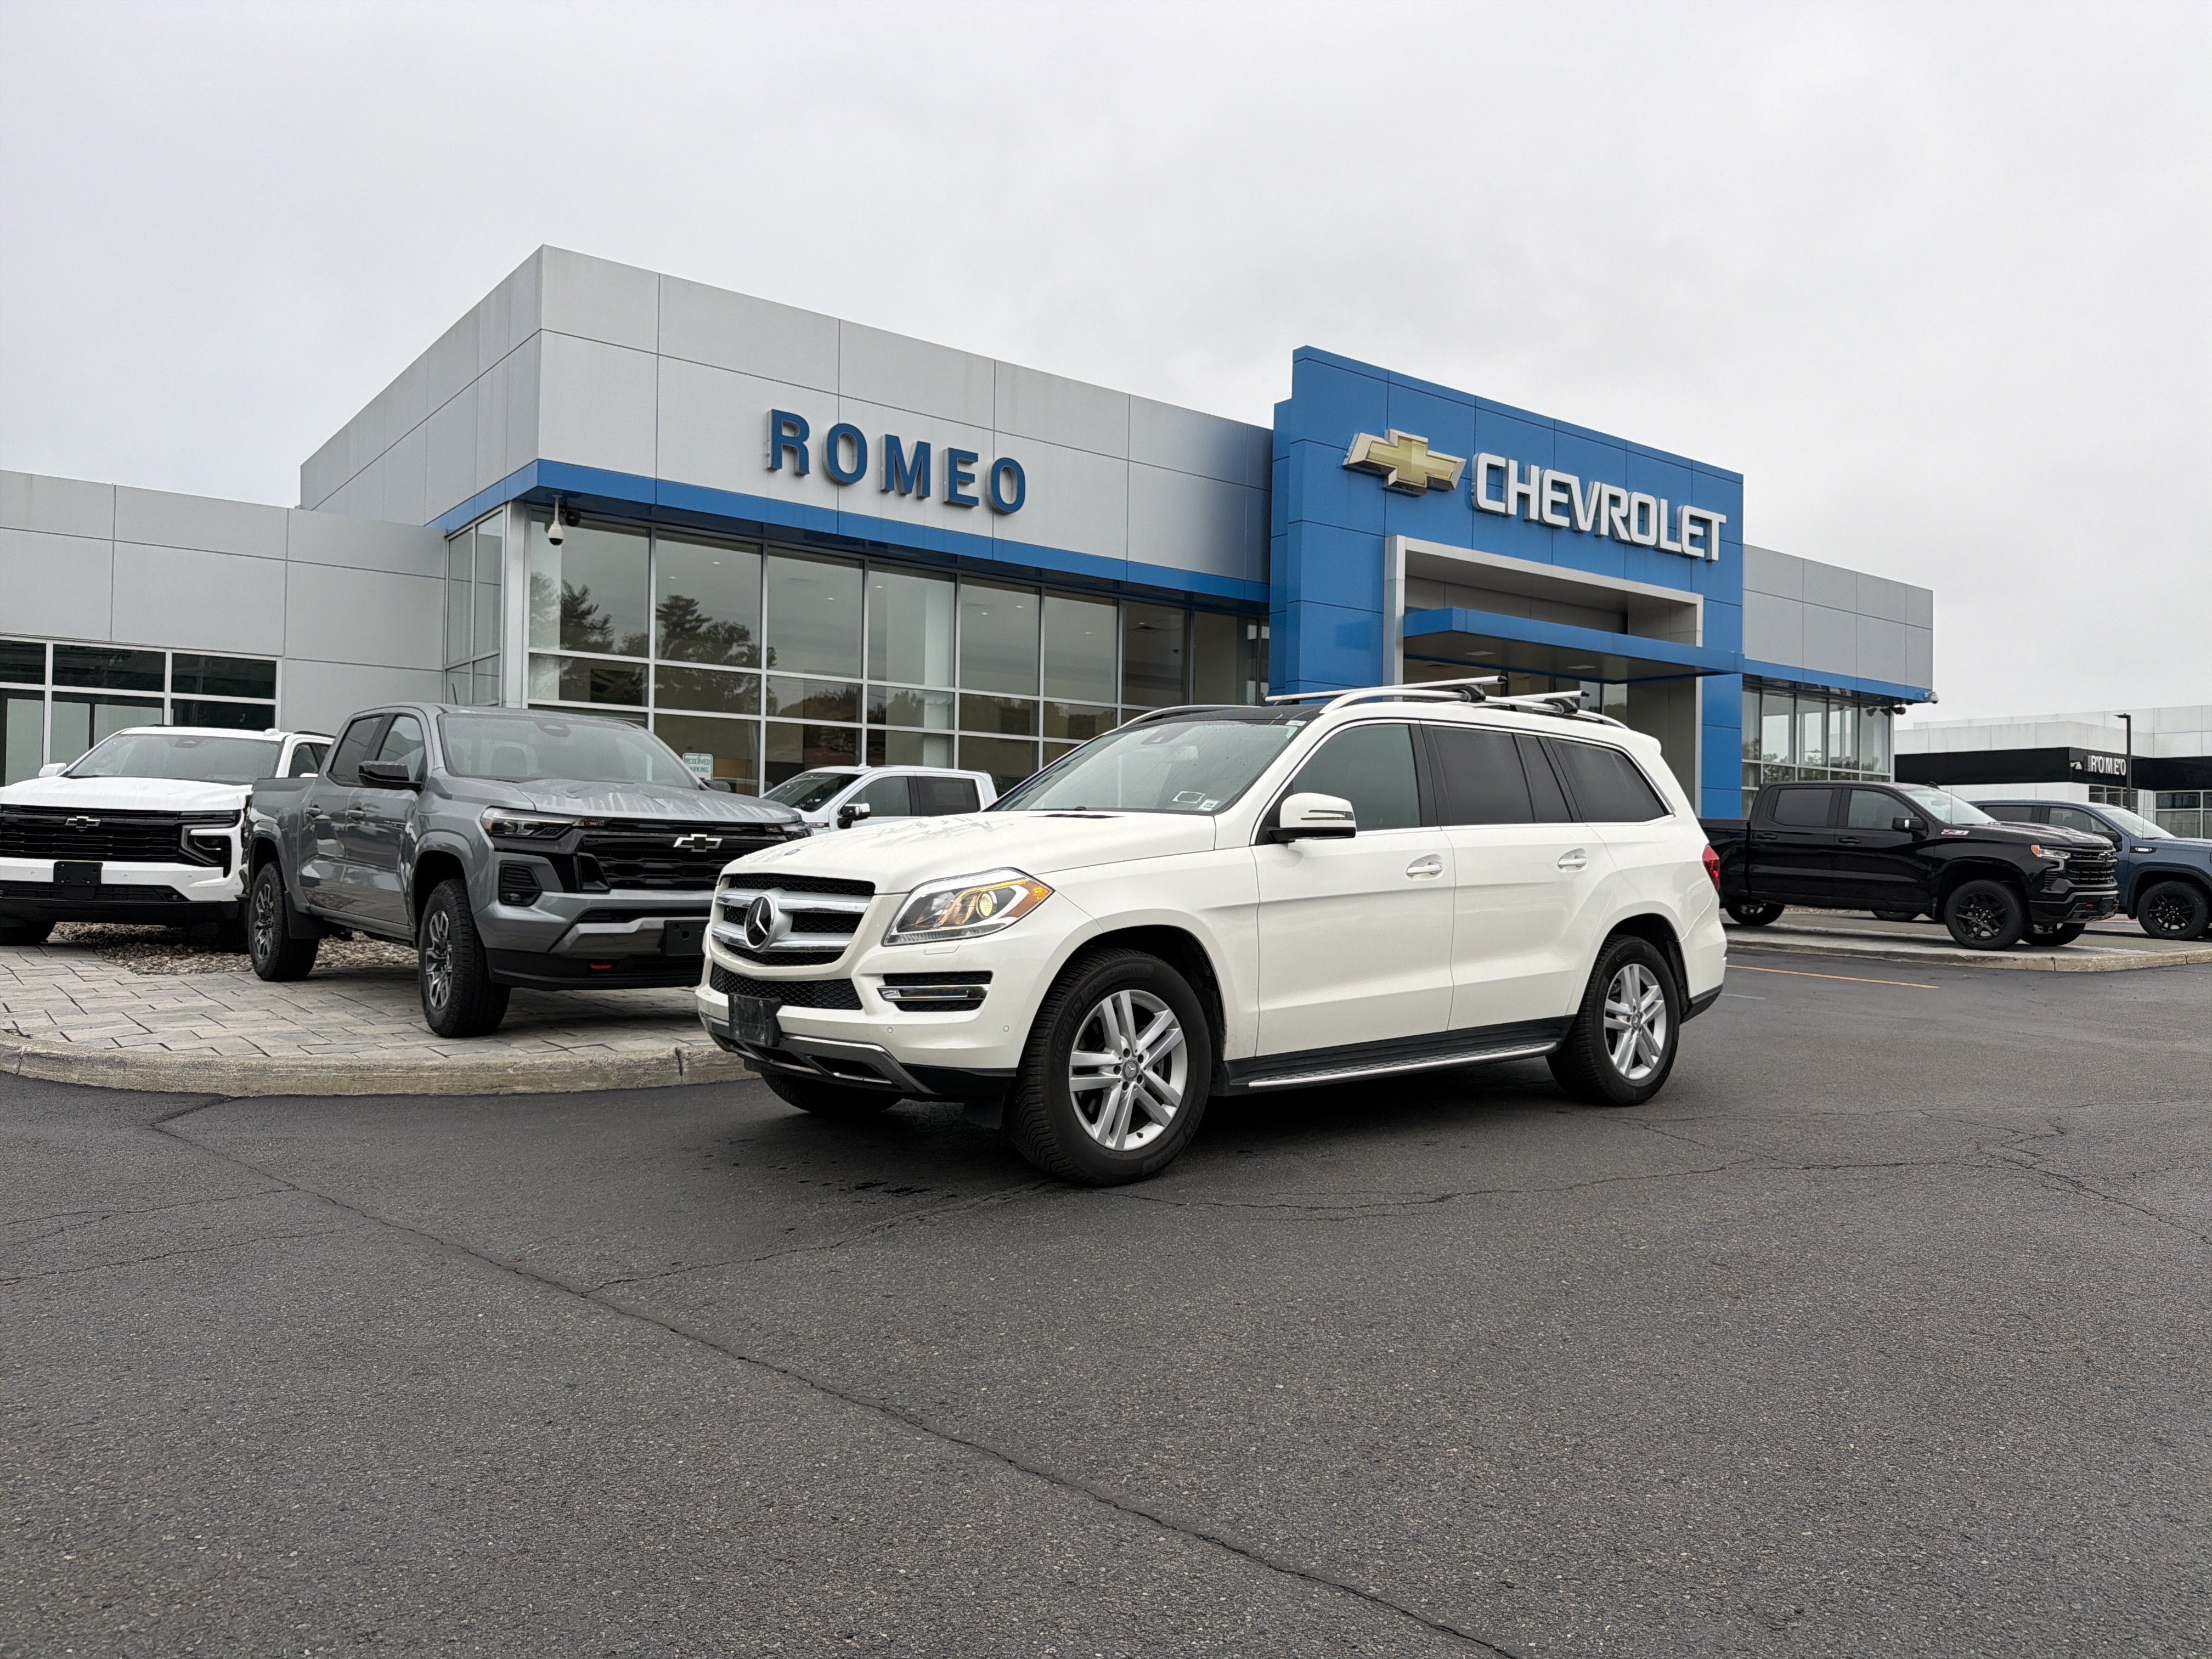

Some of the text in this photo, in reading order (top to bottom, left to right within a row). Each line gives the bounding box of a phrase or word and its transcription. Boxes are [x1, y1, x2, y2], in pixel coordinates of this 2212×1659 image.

[767, 408, 1026, 515] ROMEO
[1470, 452, 1727, 562] CHEVROLET
[2087, 754, 2126, 776] ROMEO
